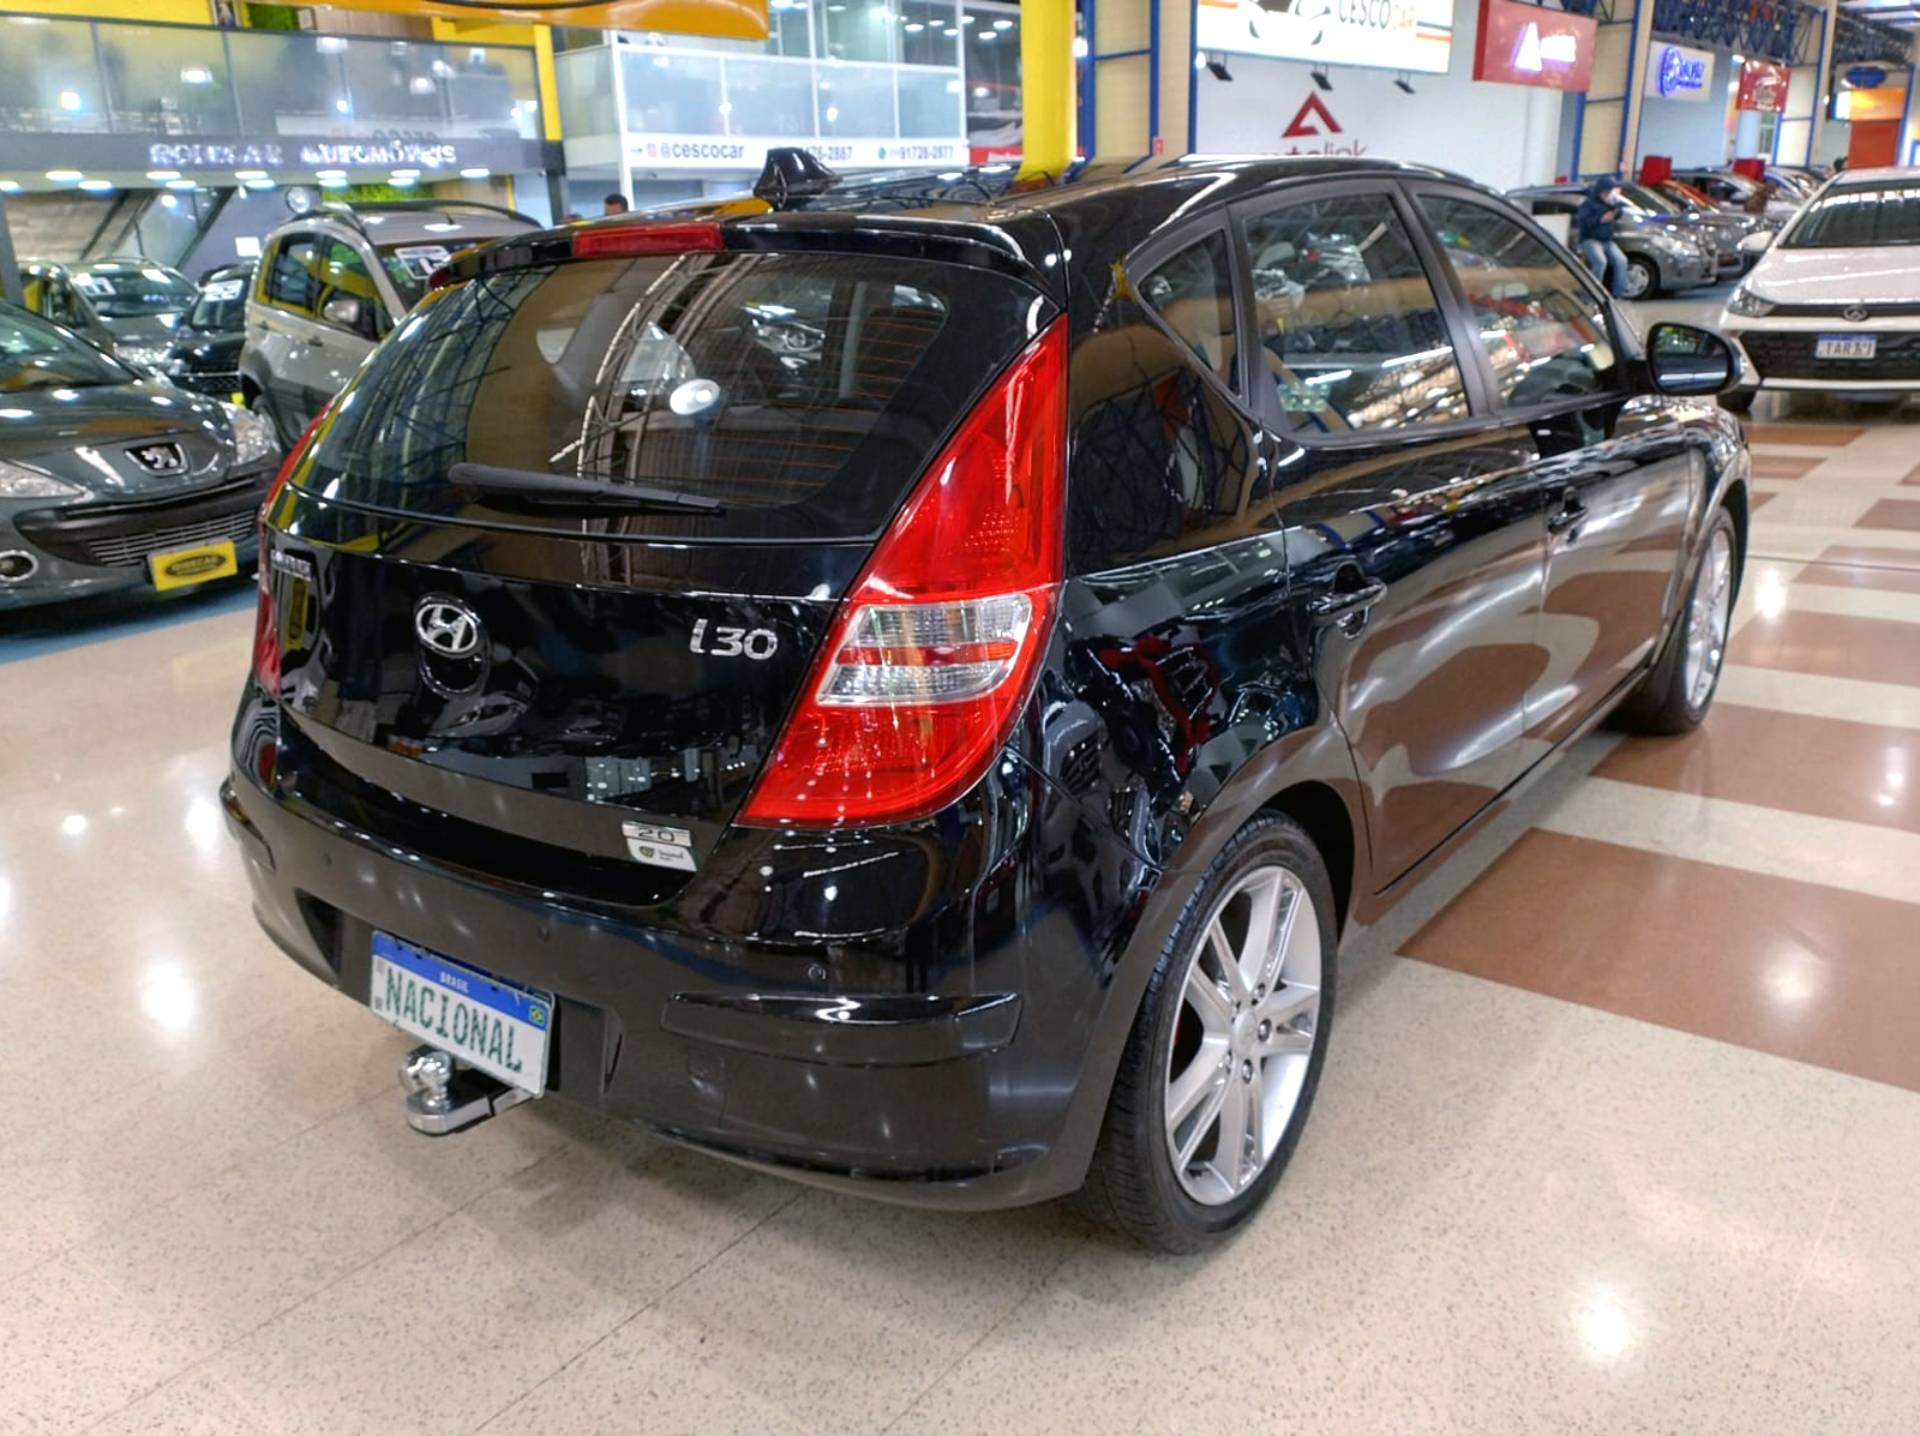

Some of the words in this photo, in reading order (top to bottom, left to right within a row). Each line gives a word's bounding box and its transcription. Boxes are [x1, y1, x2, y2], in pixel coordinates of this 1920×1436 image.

[661, 142, 744, 159] @cescocar
[439, 970, 470, 994] BRASIL
[385, 966, 522, 1073] NACIONAL
